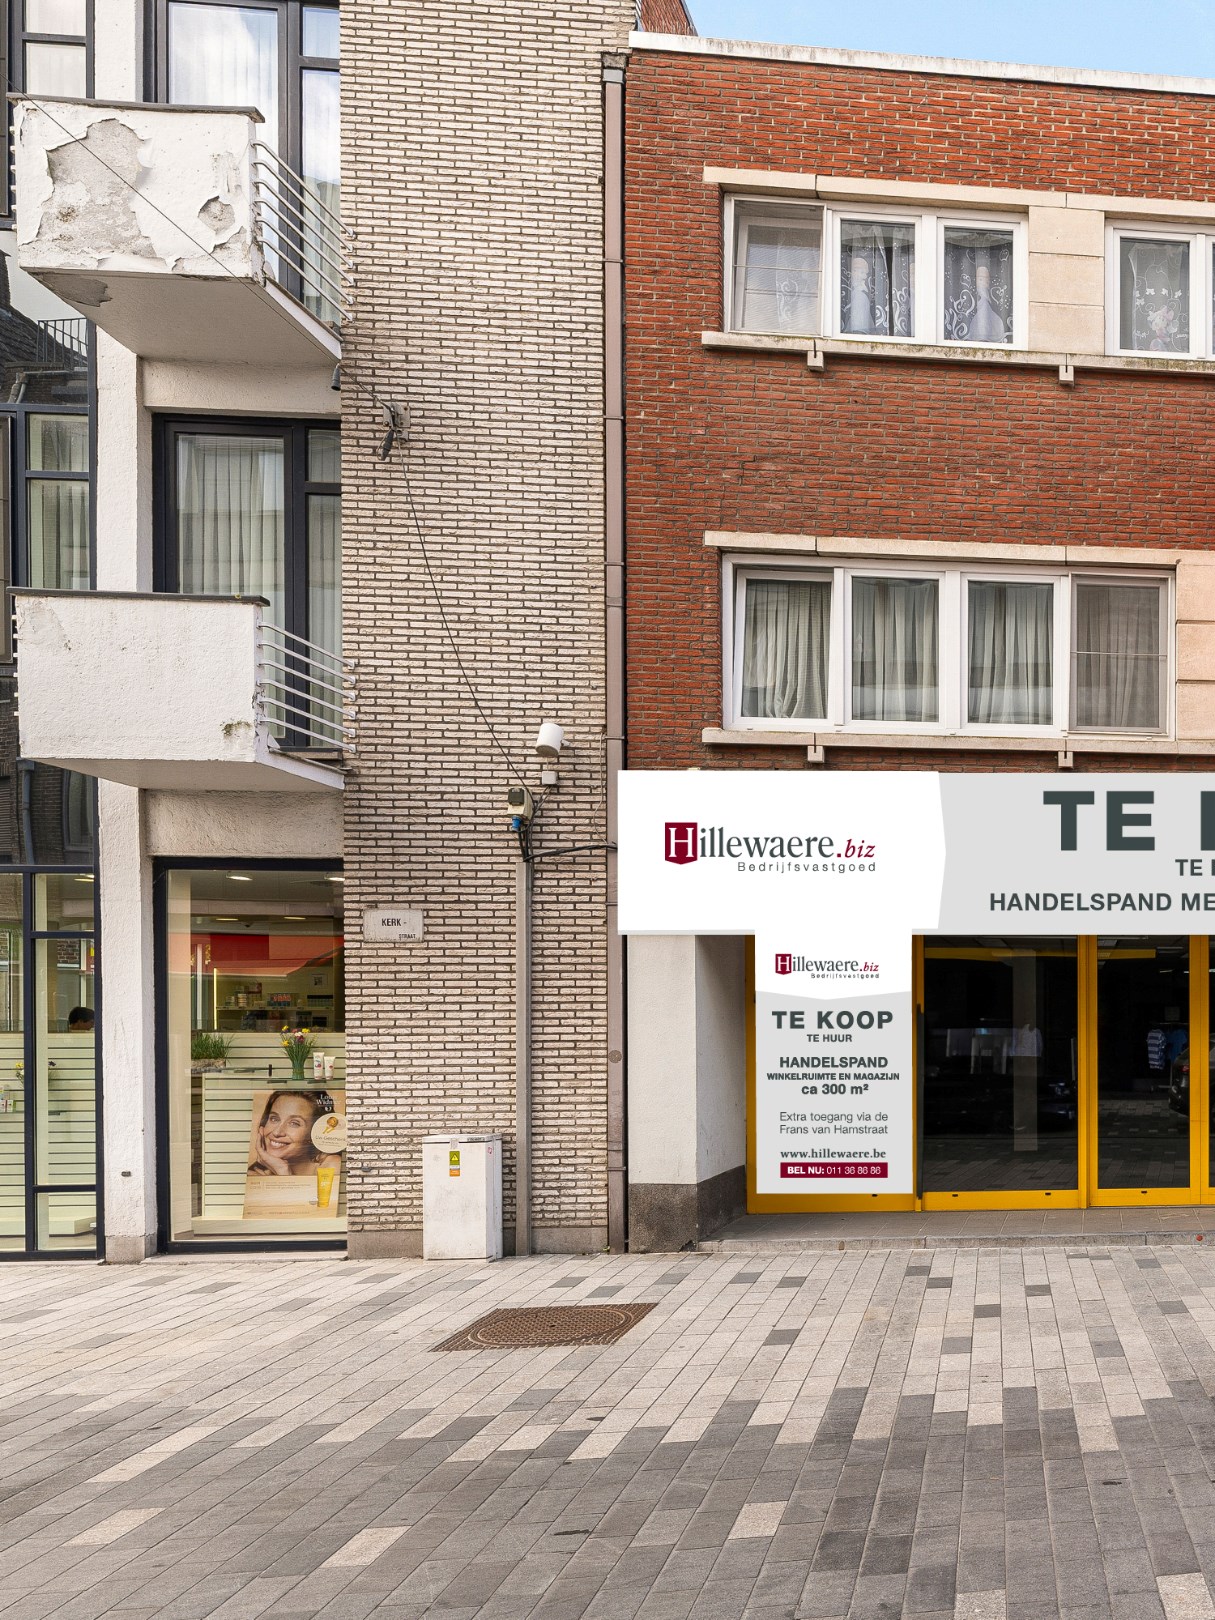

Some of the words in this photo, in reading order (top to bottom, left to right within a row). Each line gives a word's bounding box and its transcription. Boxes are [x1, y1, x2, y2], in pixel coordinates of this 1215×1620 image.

[1043, 790, 1156, 852] TE
[737, 861, 876, 874] Bedrijfsvastgoed
[1175, 858, 1203, 877] TE
[989, 892, 1172, 912] HANDELSPAND
[772, 1010, 805, 1030] TE
[816, 1010, 894, 1030] KOOP
[806, 1033, 820, 1043] TE
[822, 1033, 853, 1043] HUUR
[779, 1056, 889, 1069] HANDELSPAND
[766, 1072, 837, 1081] WINKELRUIMTE
[838, 1072, 851, 1081] EN
[853, 1072, 900, 1081] MAGAZIJN
[801, 1085, 818, 1095] ca
[821, 1083, 847, 1095] 300
[779, 1111, 807, 1122] Extra
[809, 1112, 854, 1124] toegang
[856, 1111, 872, 1122] via
[874, 1111, 889, 1122] de
[779, 1124, 809, 1135] Frans
[811, 1126, 831, 1135] van
[833, 1124, 889, 1135] Hamstraat
[780, 1148, 887, 1159] www.hillewaere.be
[787, 1166, 806, 1175] BEL
[807, 1166, 825, 1175] NU:
[826, 1166, 842, 1175] 011
[844, 1166, 856, 1175] 36
[857, 1166, 869, 1175] 86
[870, 1166, 882, 1175] 86
